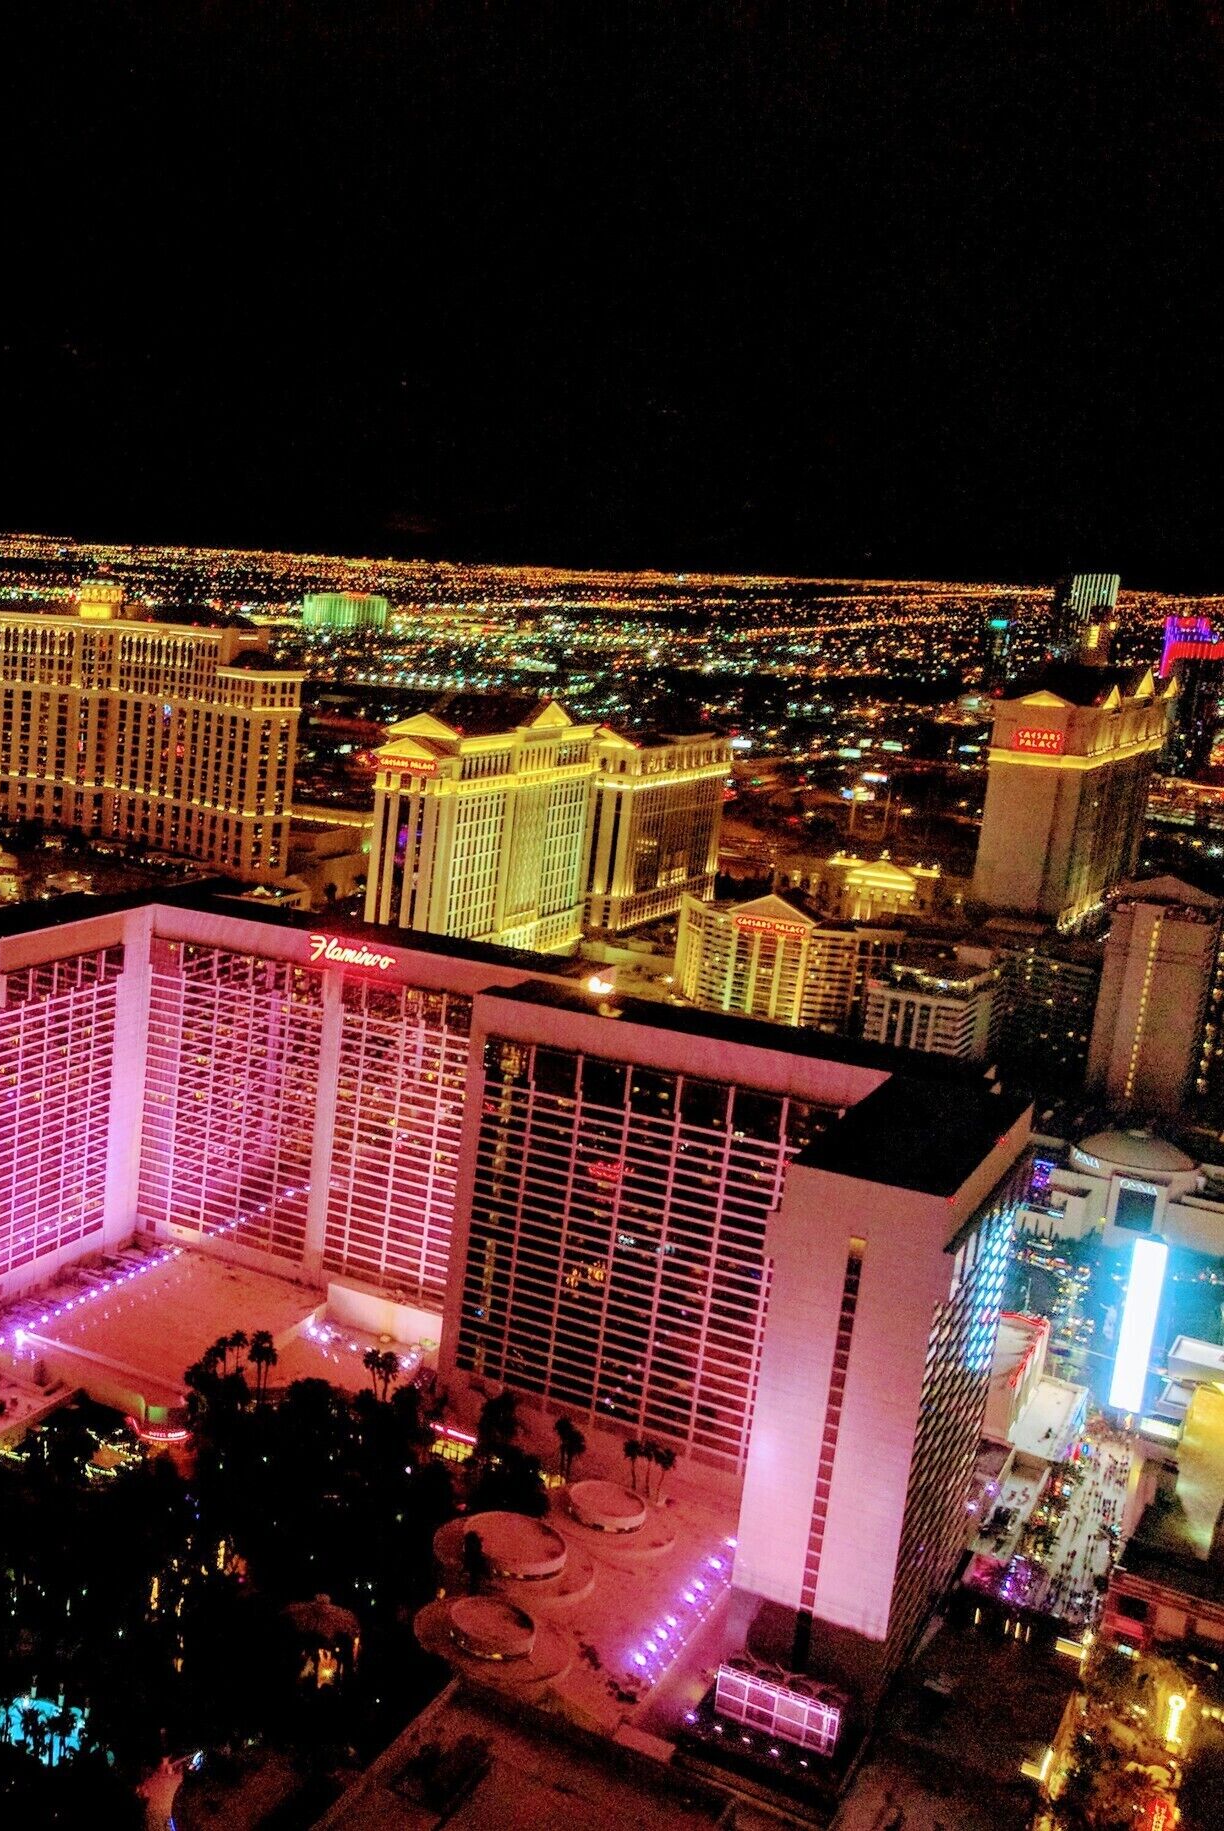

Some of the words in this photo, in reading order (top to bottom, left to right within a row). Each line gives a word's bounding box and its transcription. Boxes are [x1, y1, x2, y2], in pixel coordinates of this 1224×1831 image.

[1017, 730, 1061, 741] CAESARS
[1018, 739, 1058, 749] PALACE
[737, 917, 772, 929] CAESARS
[775, 923, 805, 935] PALACE
[1119, 1178, 1158, 1196] OMNIA
